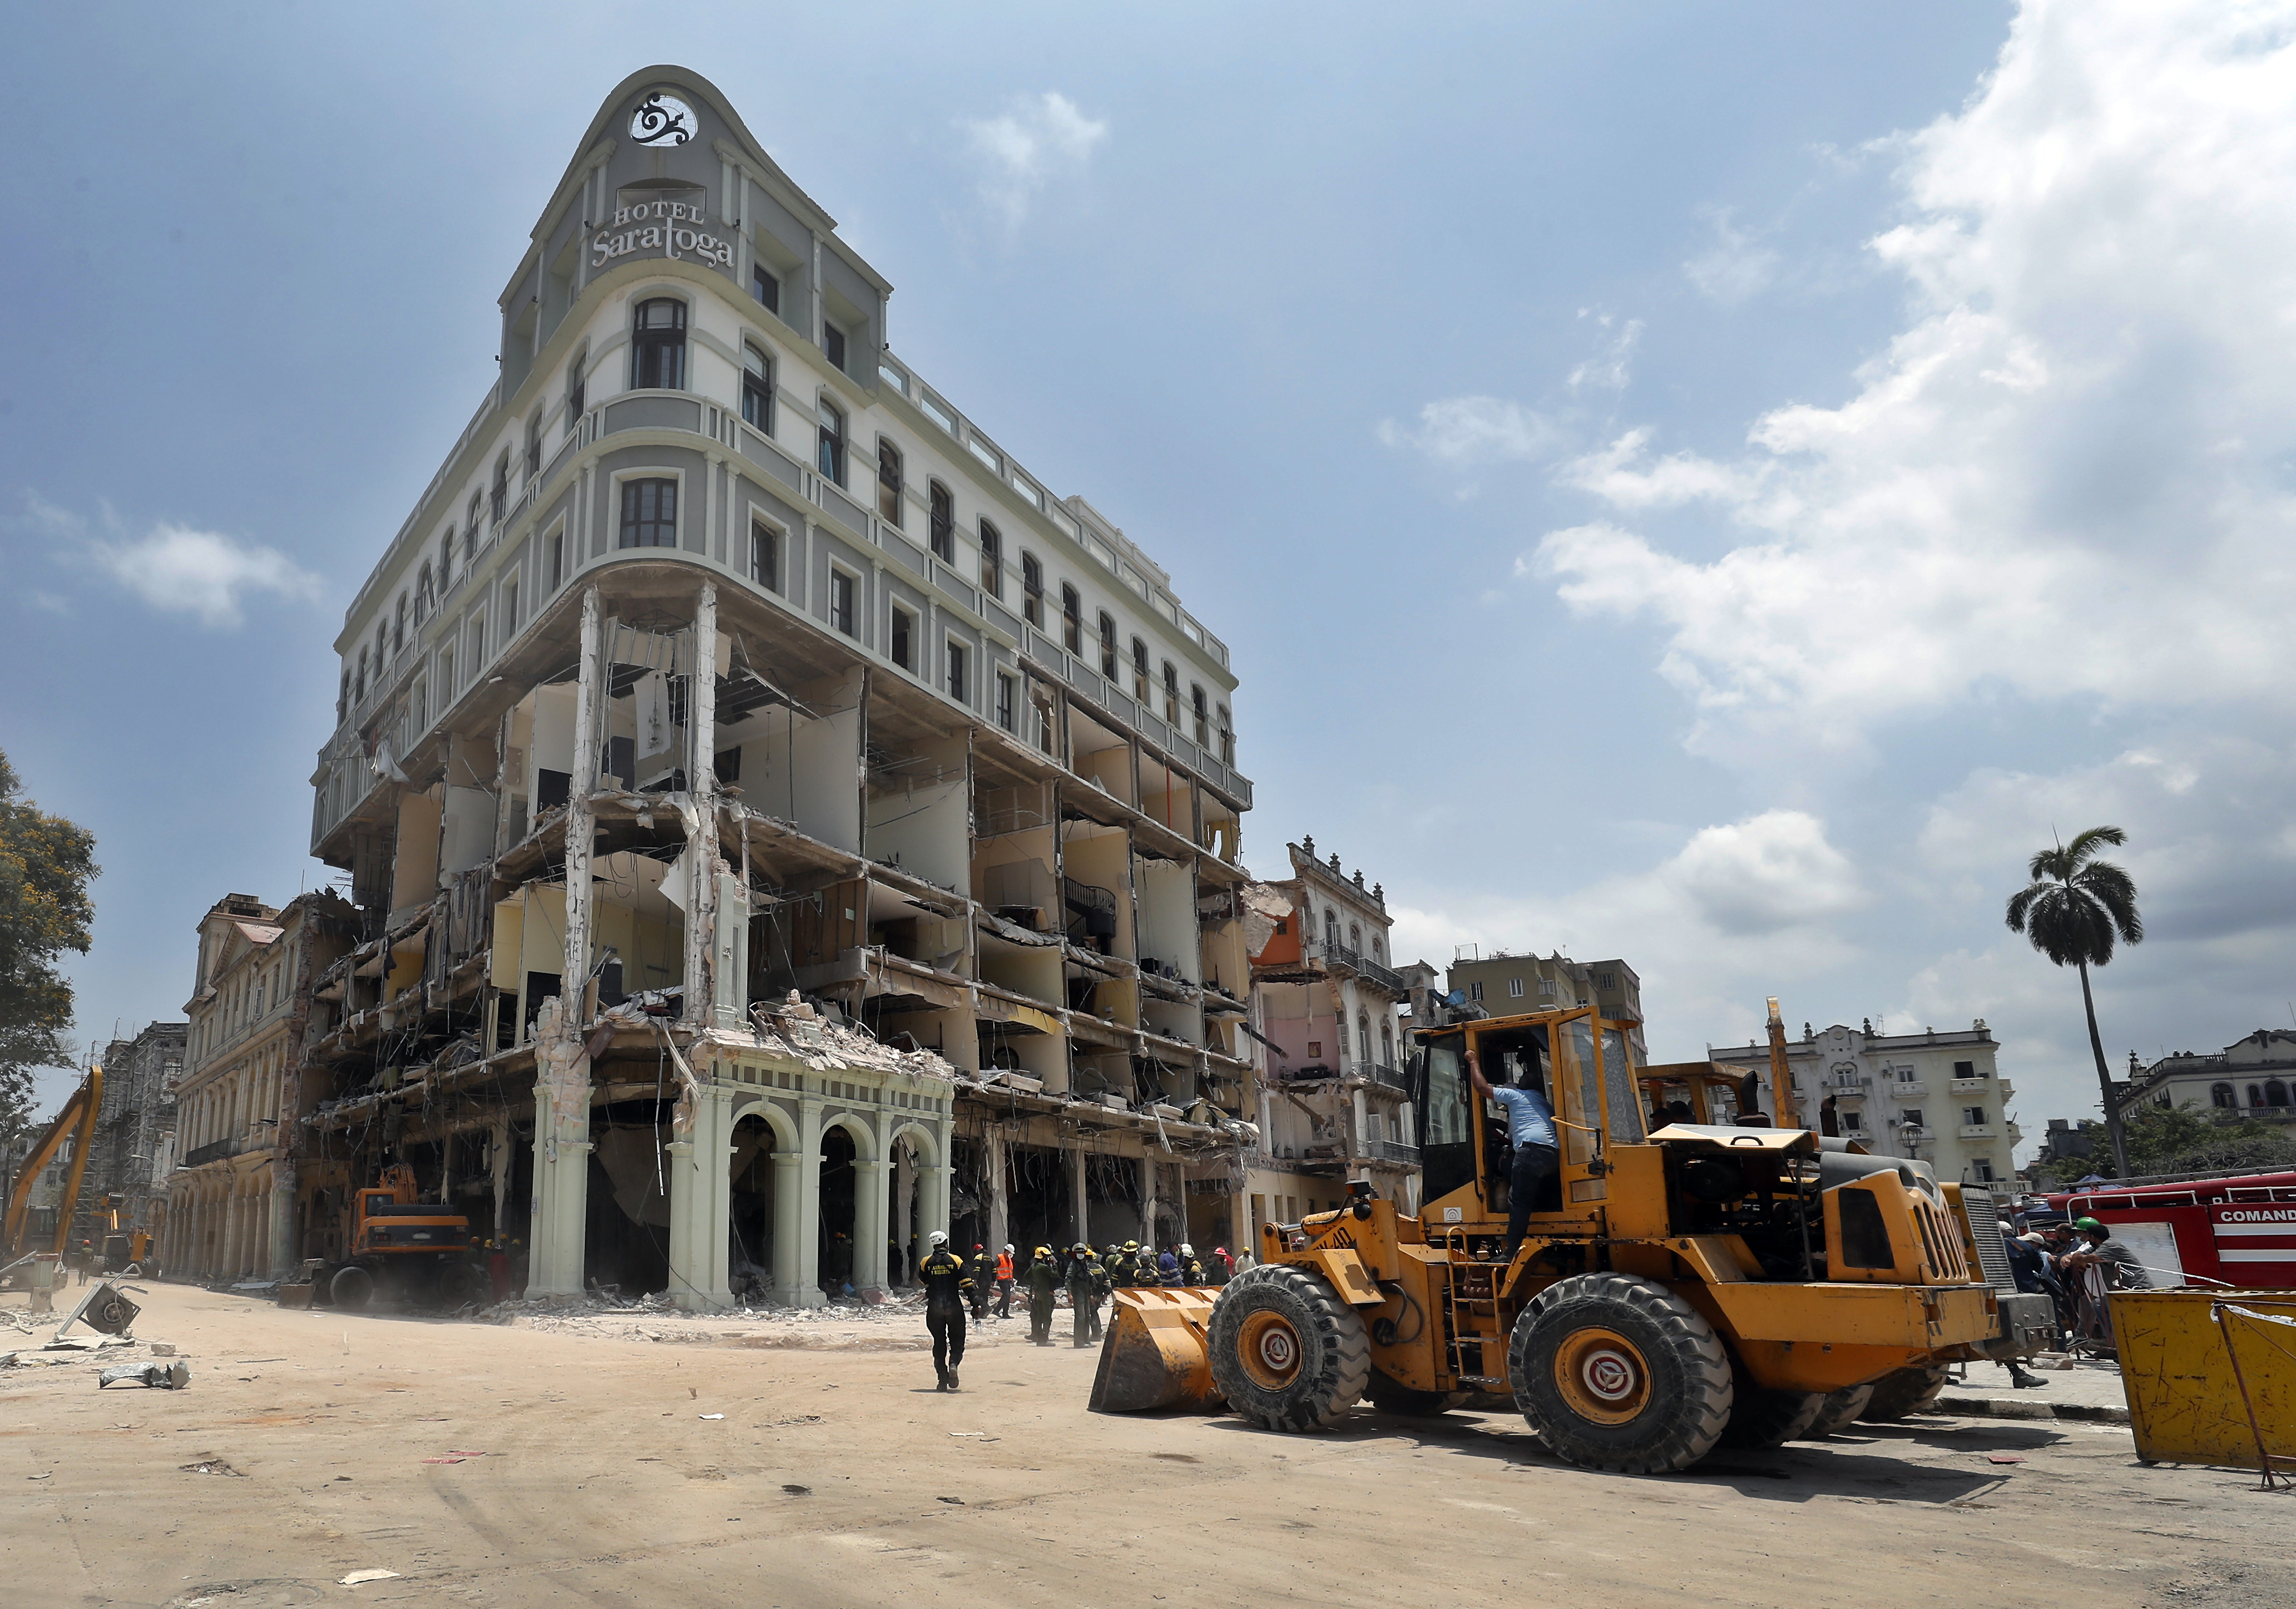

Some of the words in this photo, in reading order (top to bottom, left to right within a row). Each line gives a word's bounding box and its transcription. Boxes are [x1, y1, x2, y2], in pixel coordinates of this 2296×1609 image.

[613, 201, 704, 228] HOTEL
[592, 217, 734, 268] Saratoga
[2220, 1210, 2296, 1222] COMAND
